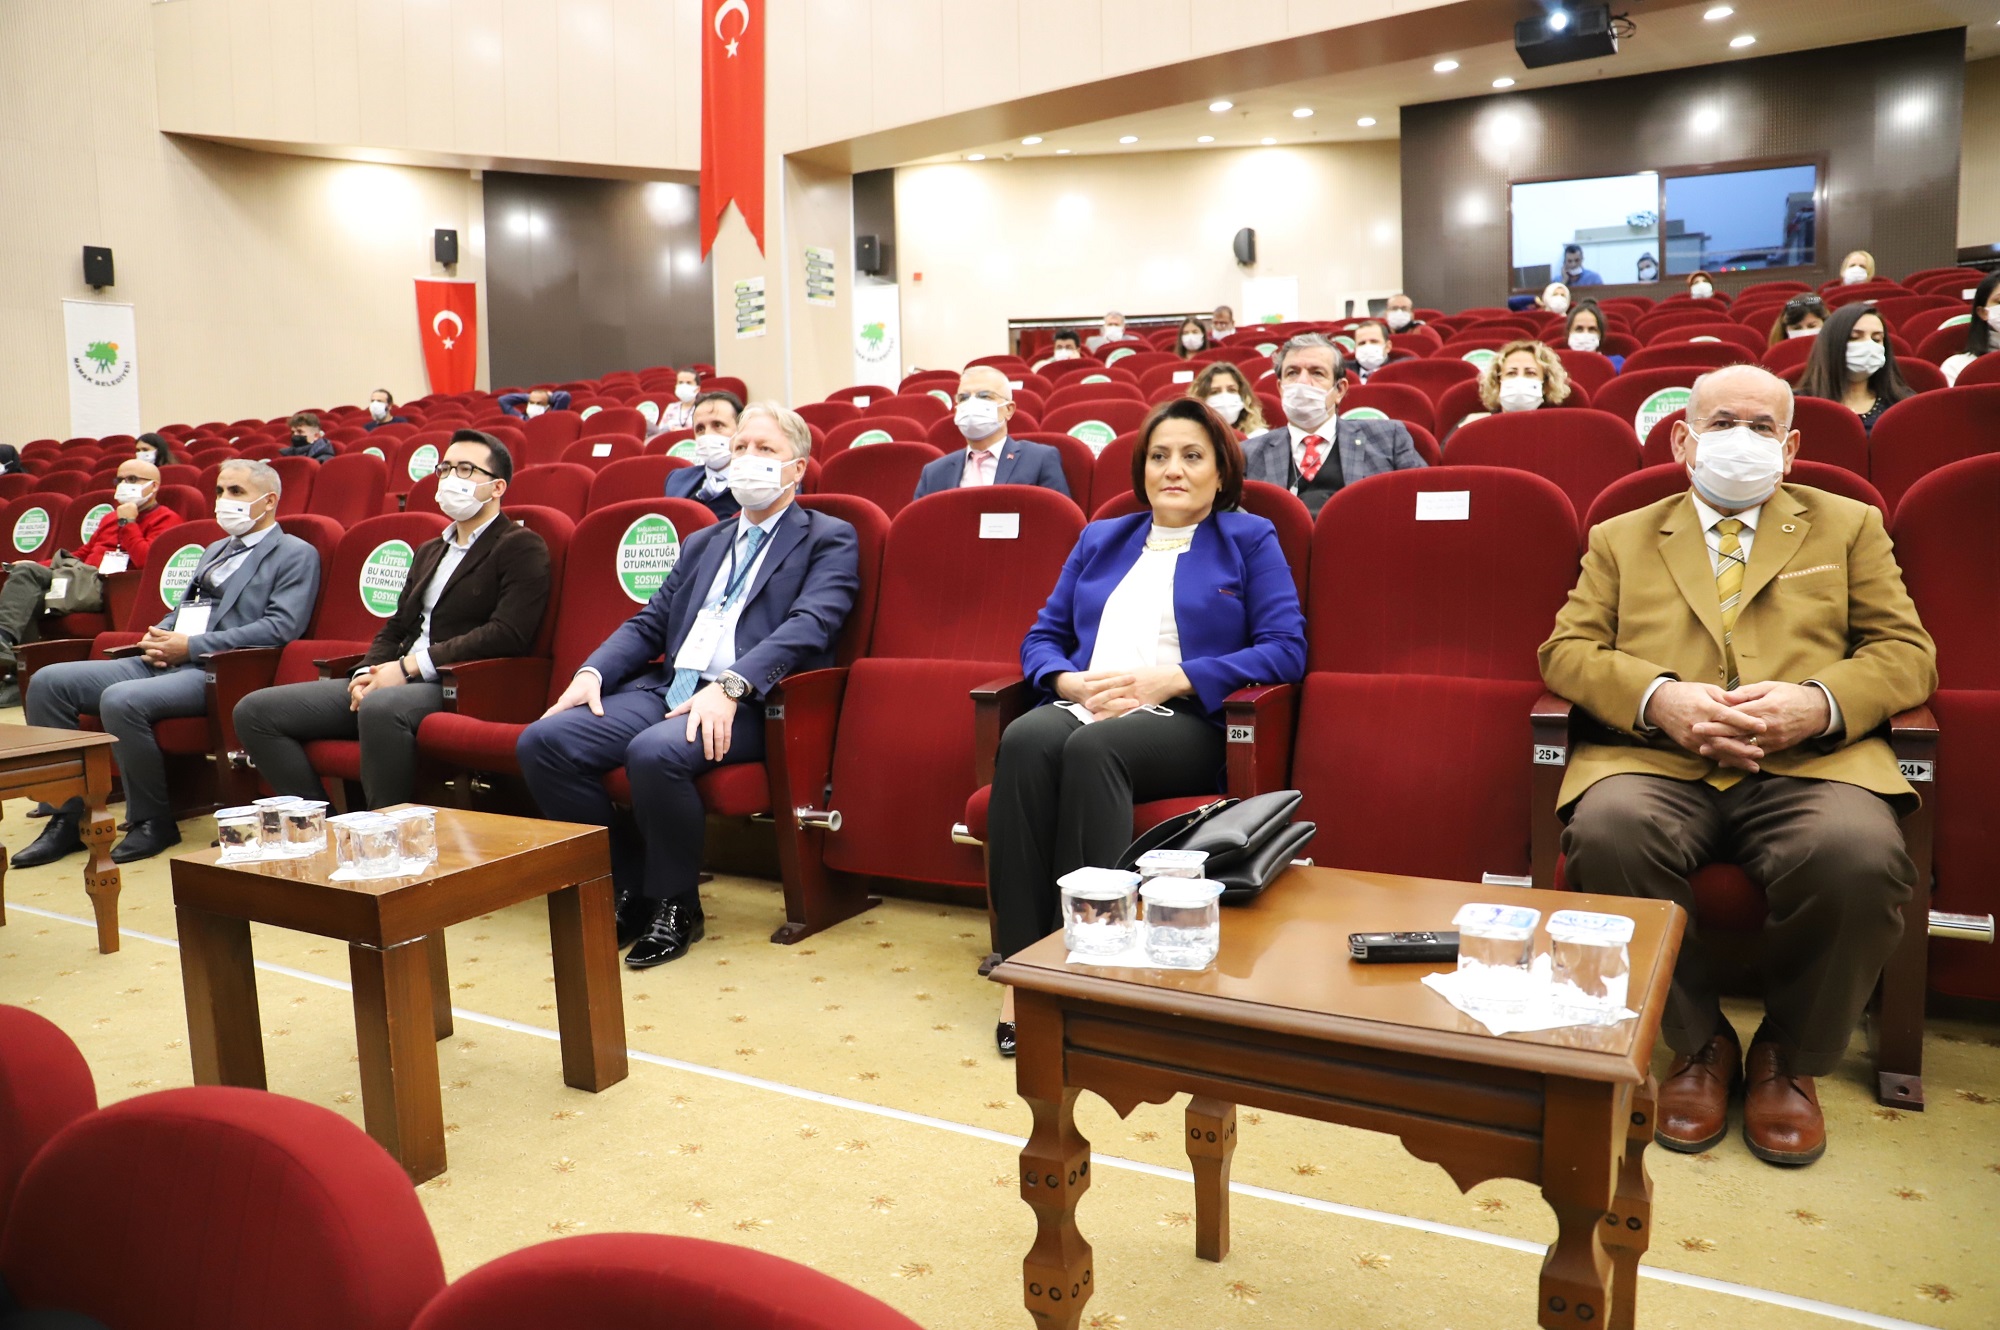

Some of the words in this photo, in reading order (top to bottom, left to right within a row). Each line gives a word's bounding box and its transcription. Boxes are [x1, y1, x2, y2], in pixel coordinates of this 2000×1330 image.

[74, 357, 92, 382] MAMAK
[636, 532, 668, 545] LÜTFEN
[624, 549, 637, 558] BU
[639, 545, 675, 558] KOLTUĞA
[379, 554, 407, 567] LÜTFEN
[623, 559, 675, 569] OTURMAYINIZ
[168, 570, 177, 578] BU
[367, 566, 379, 575] BU
[380, 568, 407, 578] KOLTUĞ
[365, 576, 405, 588] OTURMAYIN
[634, 574, 663, 585] SOSYAL
[372, 590, 398, 602] SOSYAL
[1231, 729, 1242, 739] 26
[1538, 749, 1552, 760] 25
[1900, 764, 1915, 776] 24
